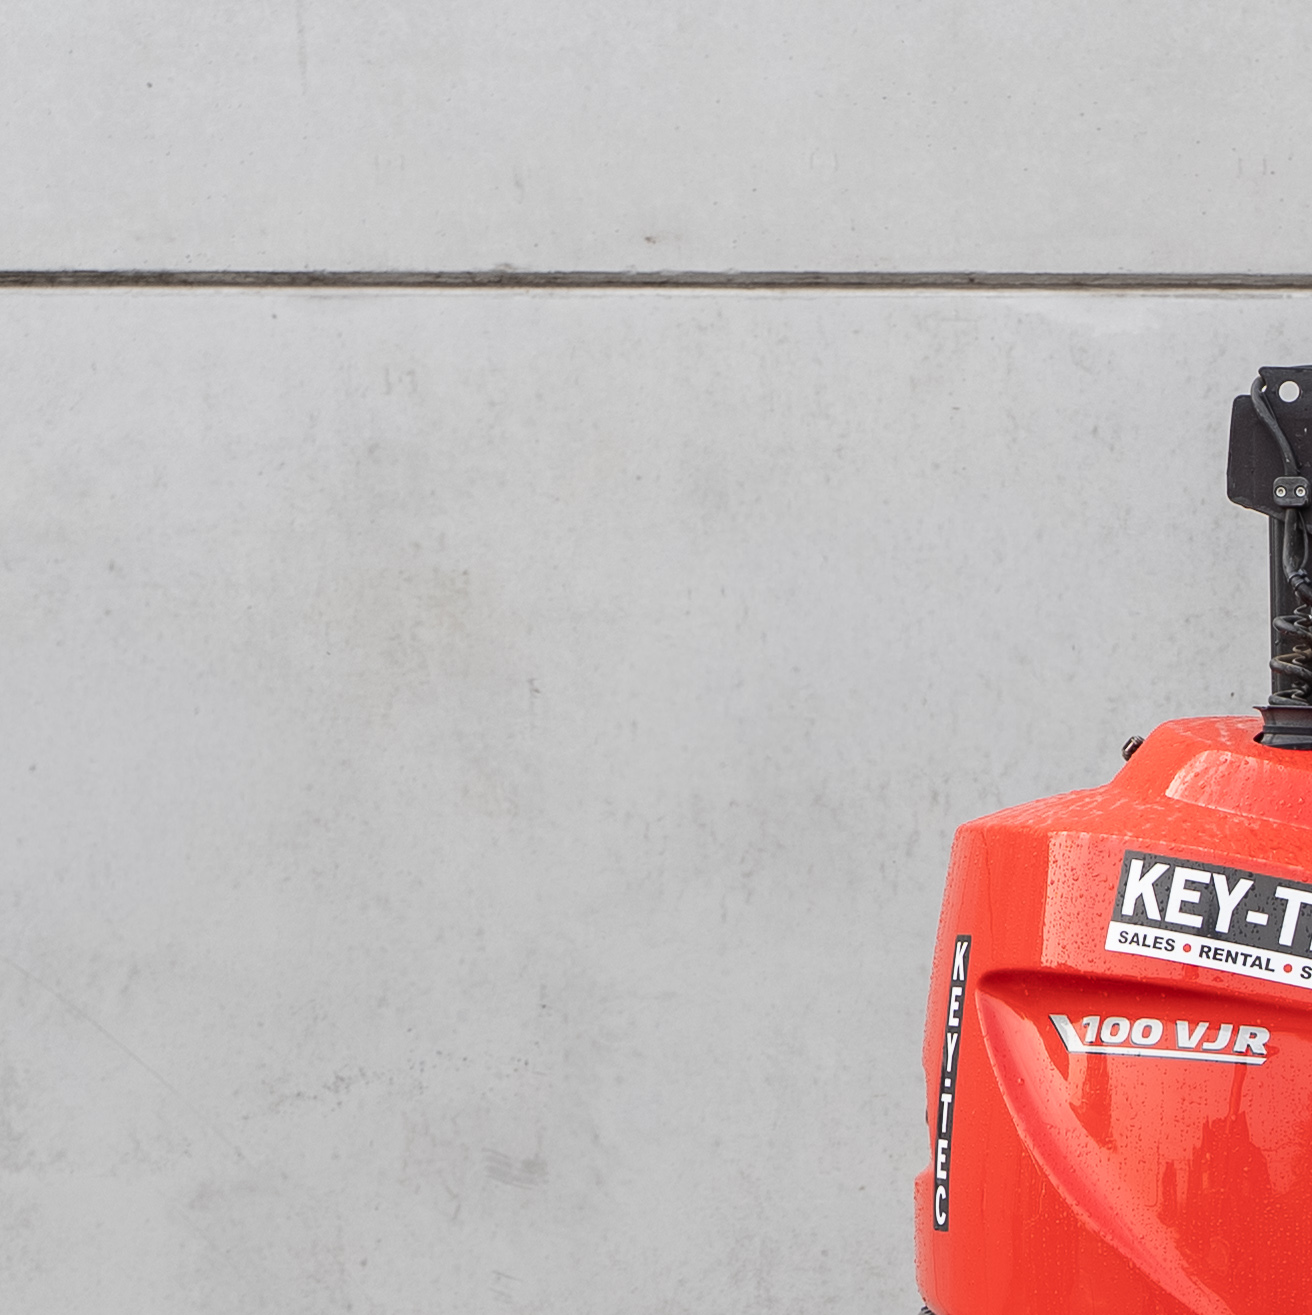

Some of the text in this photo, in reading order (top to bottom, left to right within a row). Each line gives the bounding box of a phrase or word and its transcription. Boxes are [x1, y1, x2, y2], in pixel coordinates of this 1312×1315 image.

[1118, 930, 1176, 952] SALES
[1198, 944, 1275, 973] RENTAL
[1081, 1015, 1271, 1055] 100 VJR
[935, 941, 968, 1226] KEY-TEC
